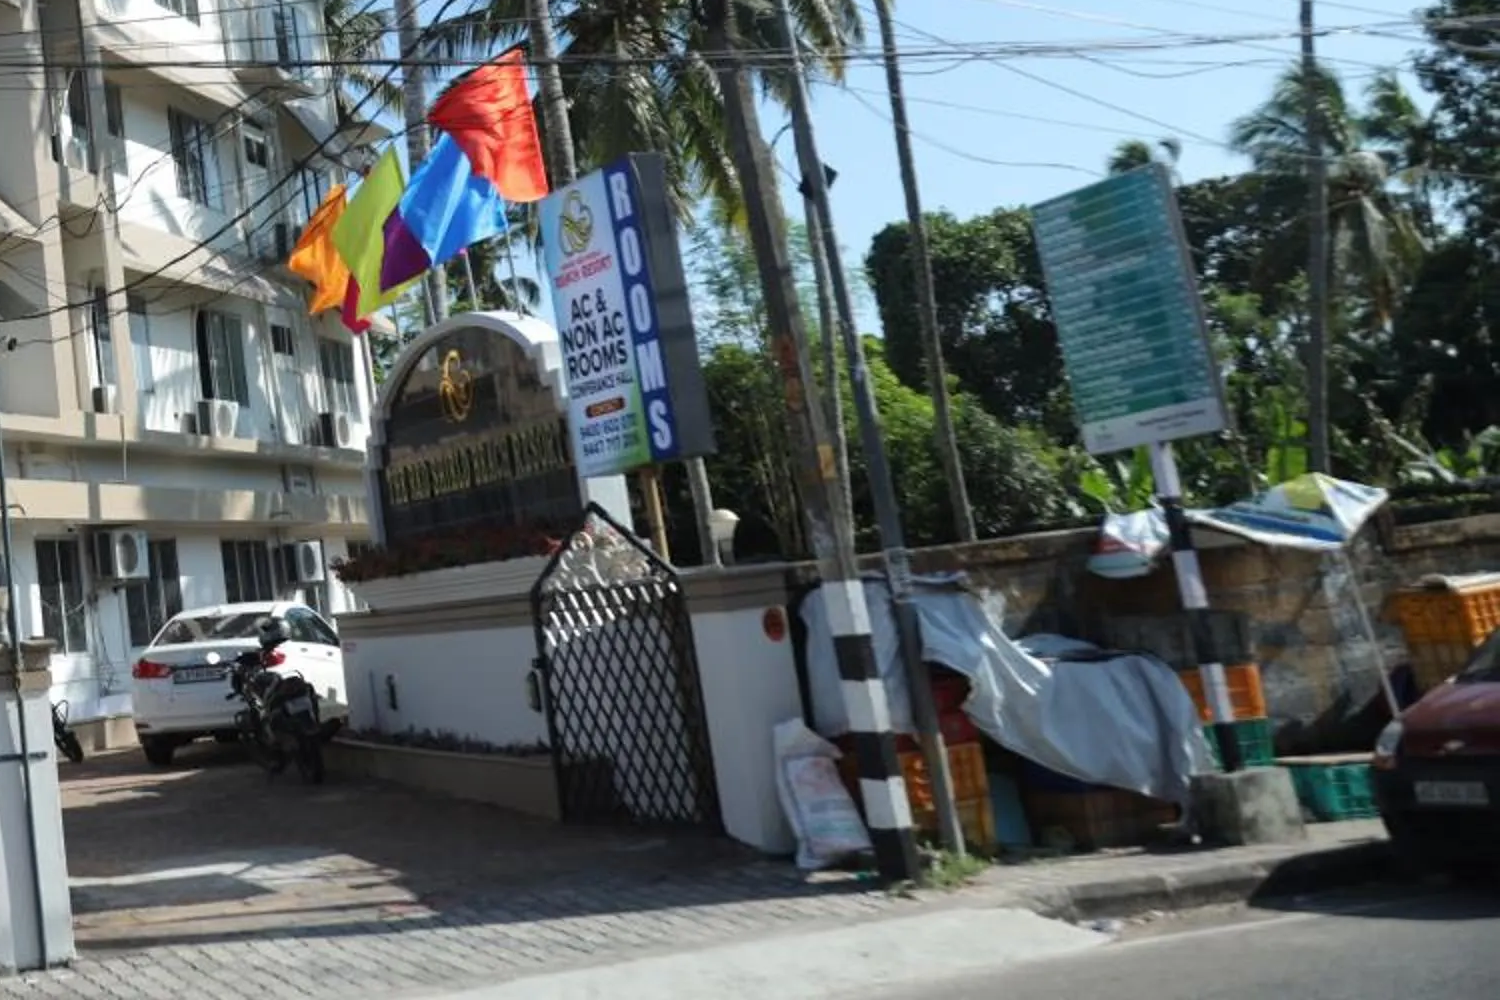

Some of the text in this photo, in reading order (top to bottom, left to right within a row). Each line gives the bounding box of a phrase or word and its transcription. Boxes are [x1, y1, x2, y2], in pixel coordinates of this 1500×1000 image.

[571, 288, 607, 321] AC &
[609, 172, 672, 449] ROOMS
[561, 311, 626, 352] NON AC
[566, 338, 629, 381] ROOMS
